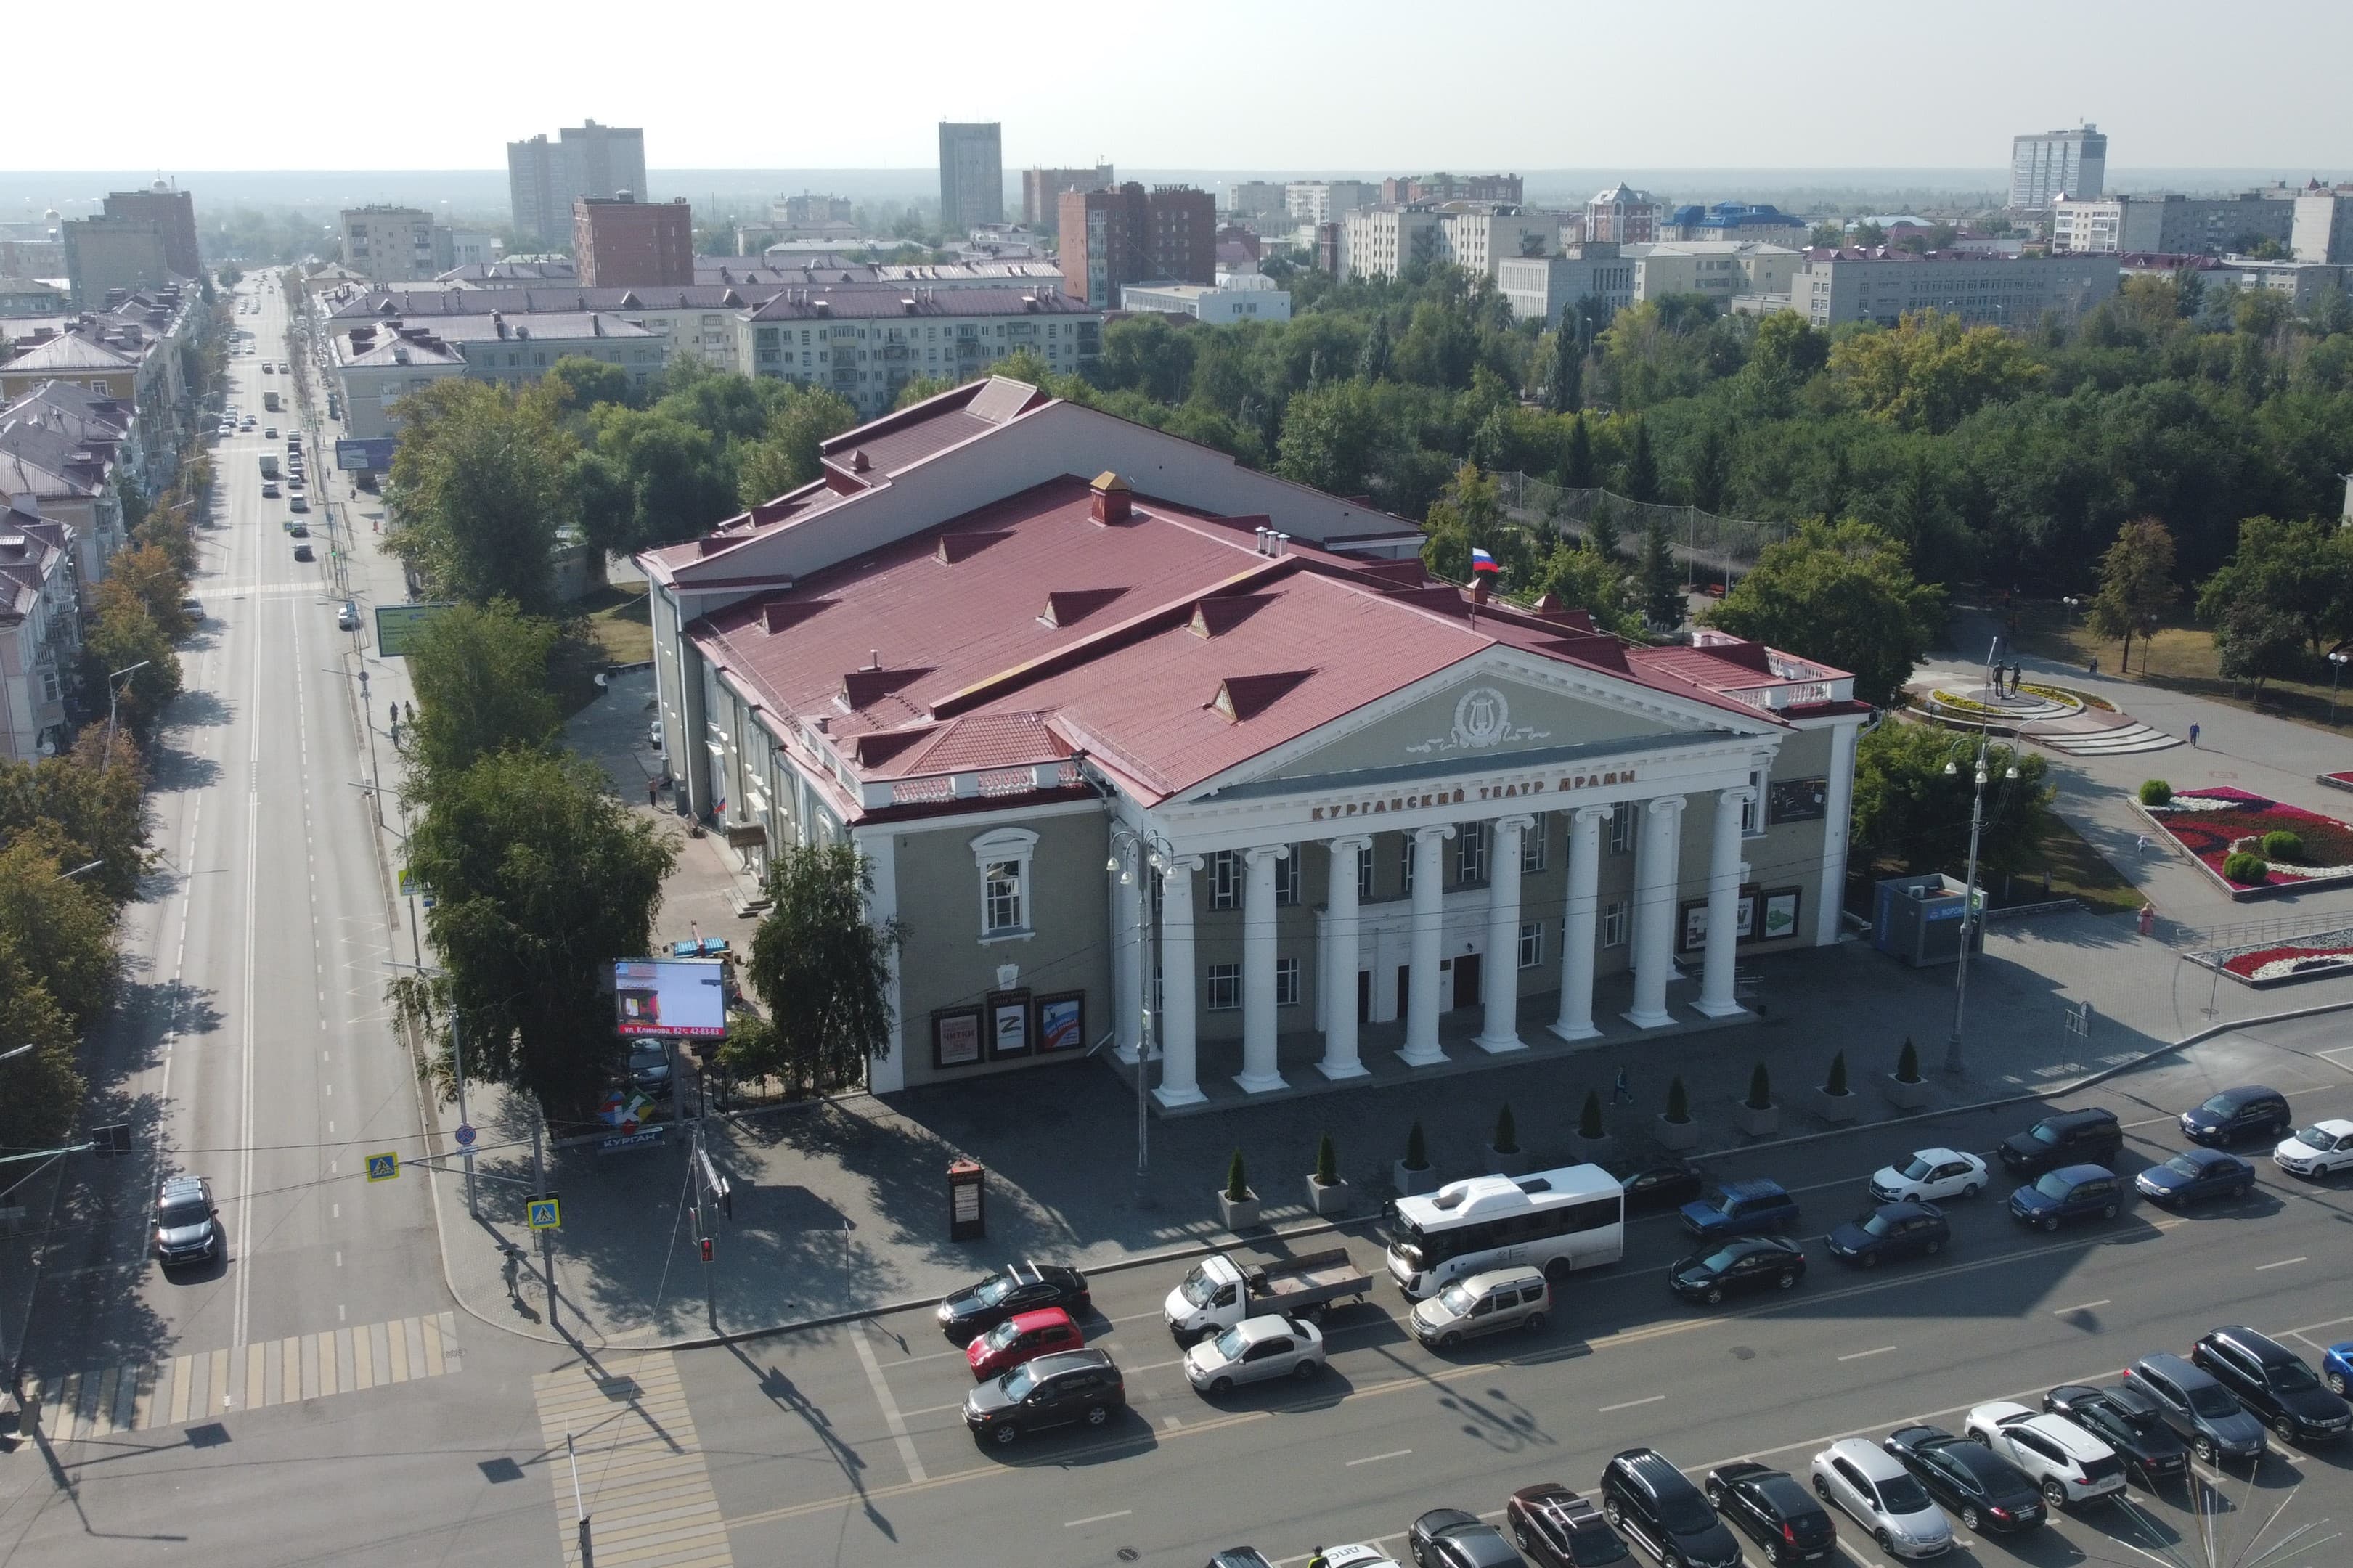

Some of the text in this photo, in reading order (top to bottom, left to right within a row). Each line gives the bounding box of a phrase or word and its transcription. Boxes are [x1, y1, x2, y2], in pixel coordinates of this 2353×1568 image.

[1312, 769, 1636, 821] КУРГАНСКИЙ ТЕАТР ДРАМЫ
[998, 1016, 1022, 1034] Z
[603, 1133, 656, 1148] КУРГАН
[1328, 1545, 1361, 1560] ДПС
